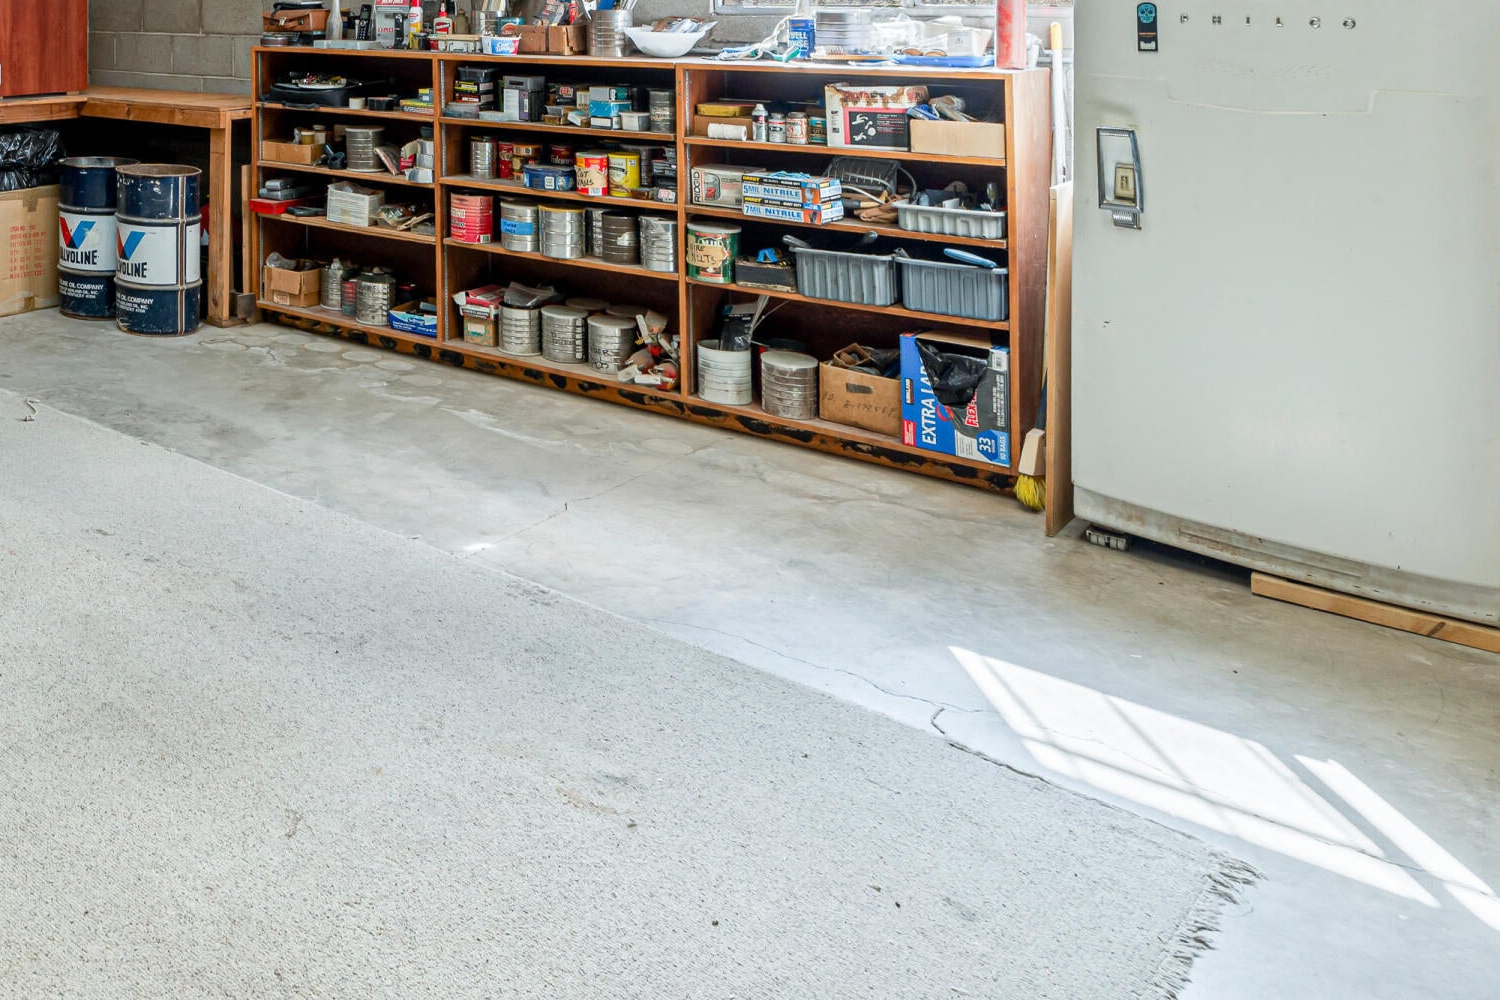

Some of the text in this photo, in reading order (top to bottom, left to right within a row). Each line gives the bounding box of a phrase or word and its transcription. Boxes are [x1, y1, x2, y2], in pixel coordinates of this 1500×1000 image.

[1180, 12, 1357, 30] PHILCO
[763, 187, 800, 198] NITRILE
[764, 208, 801, 218] NITRILE
[127, 296, 154, 305] COMPANY
[921, 399, 937, 445] EXTRA
[979, 437, 992, 453] 33
